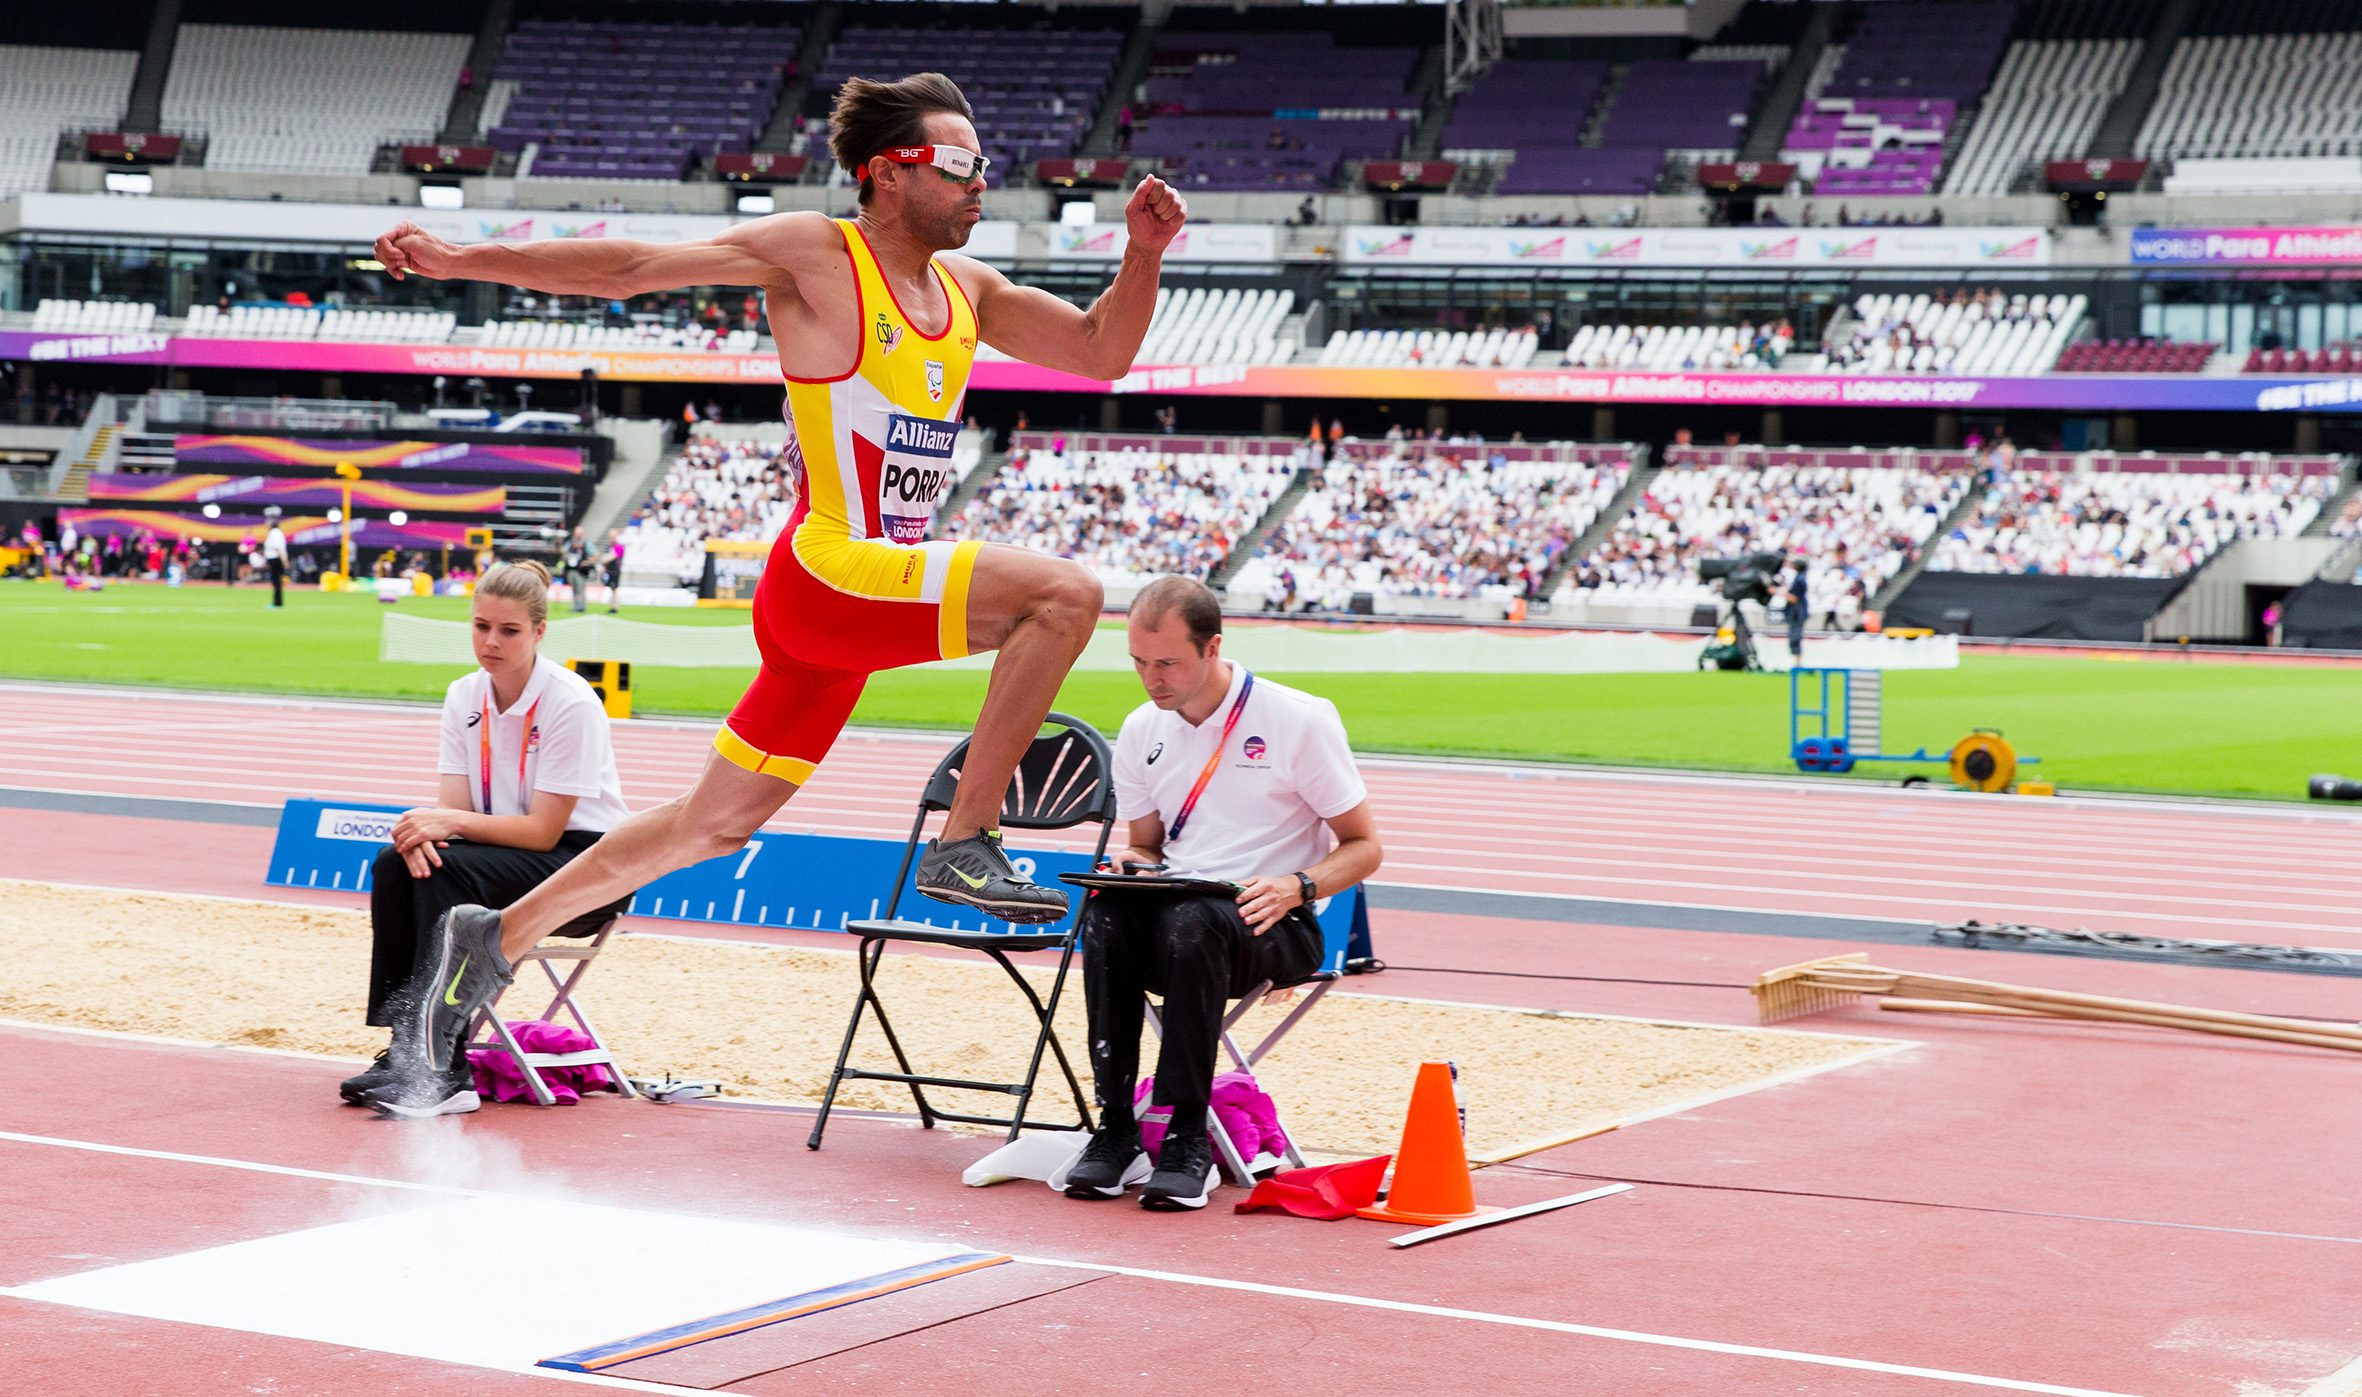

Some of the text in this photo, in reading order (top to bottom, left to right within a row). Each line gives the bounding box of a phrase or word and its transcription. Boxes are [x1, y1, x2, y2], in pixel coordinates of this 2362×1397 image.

[897, 148, 924, 158] BG
[2206, 234, 2270, 259] Para
[471, 350, 519, 370] Para
[1556, 375, 1610, 396] Para
[1612, 375, 1705, 399] Athletics
[1842, 379, 1930, 400] LONDON
[889, 419, 954, 451] Allianz
[734, 840, 764, 879] 7
